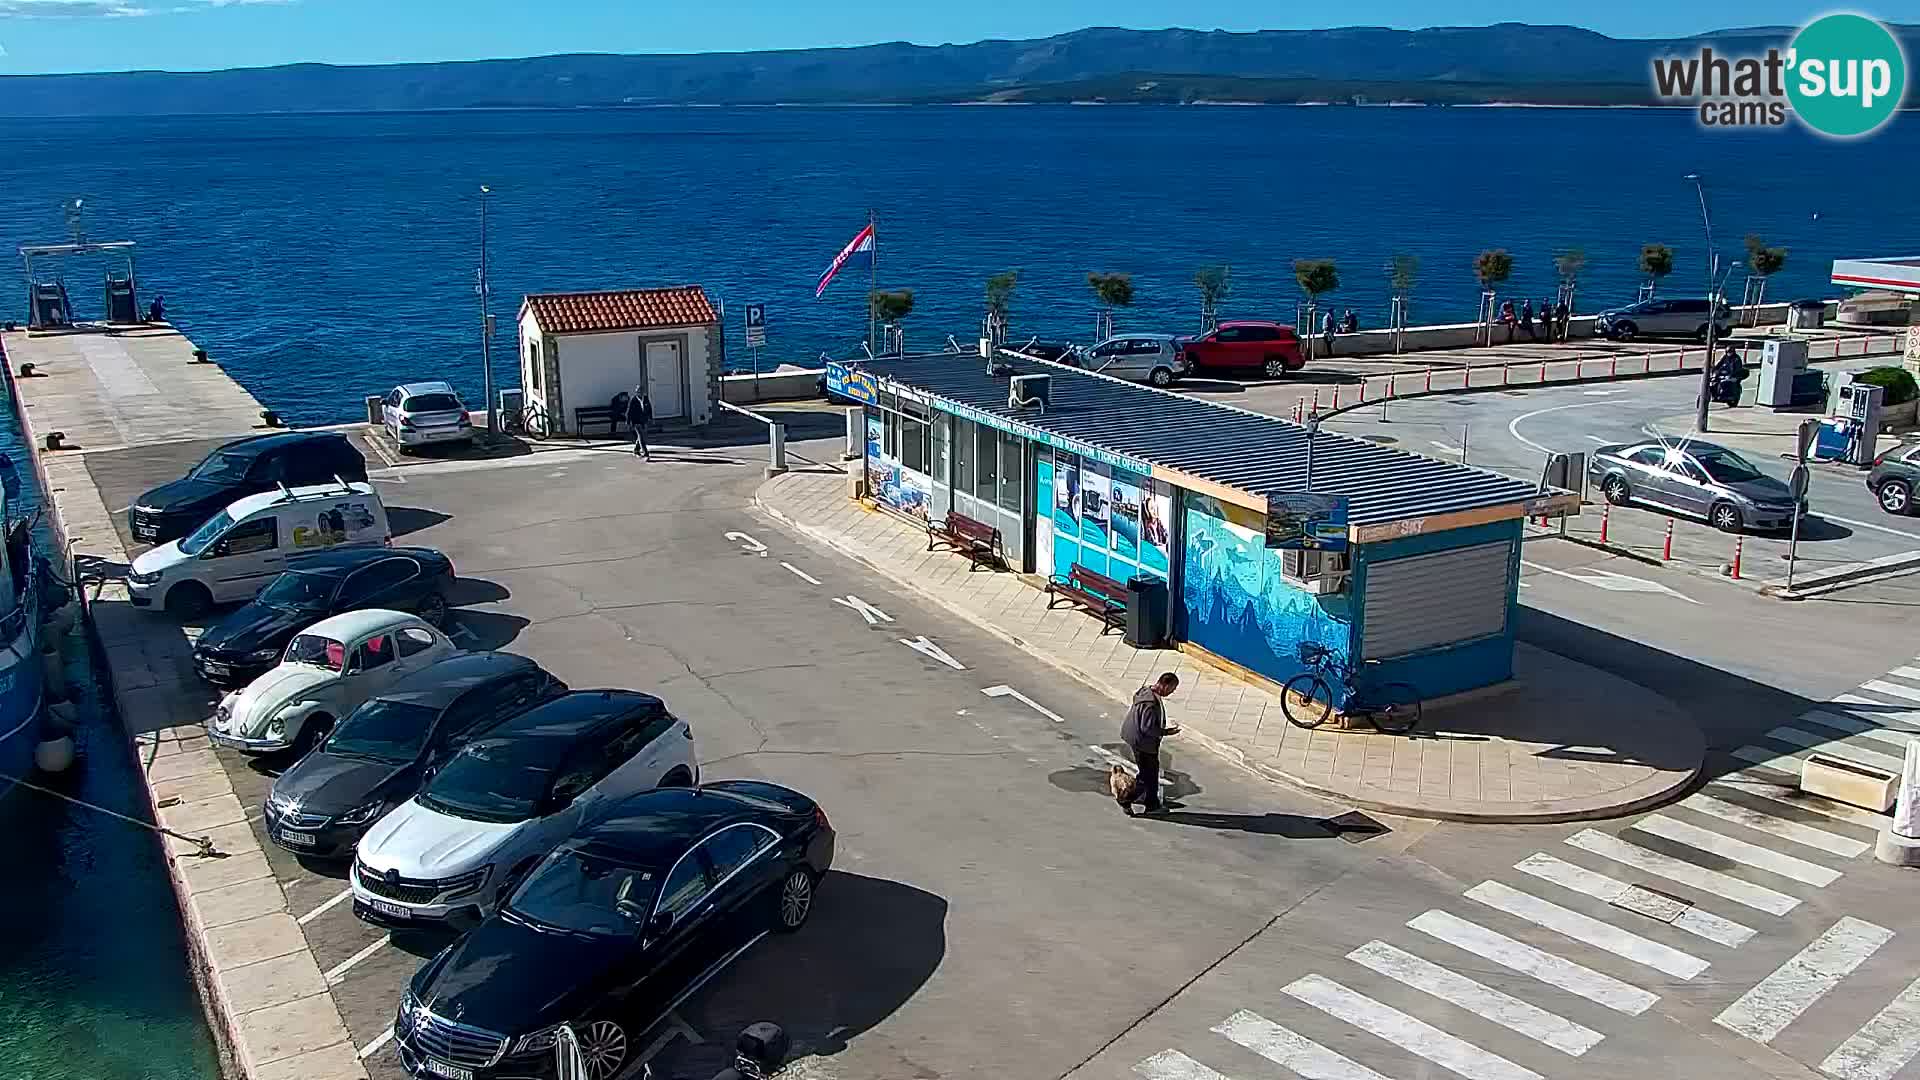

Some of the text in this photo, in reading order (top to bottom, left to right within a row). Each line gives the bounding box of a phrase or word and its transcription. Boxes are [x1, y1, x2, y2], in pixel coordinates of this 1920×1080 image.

[750, 307, 761, 324] P
[1012, 424, 1040, 441] POSTAJA
[1050, 438, 1063, 449] BUS
[1064, 440, 1095, 457] STATION
[1096, 449, 1121, 465] TICKET
[1122, 458, 1148, 473] OFFICE
